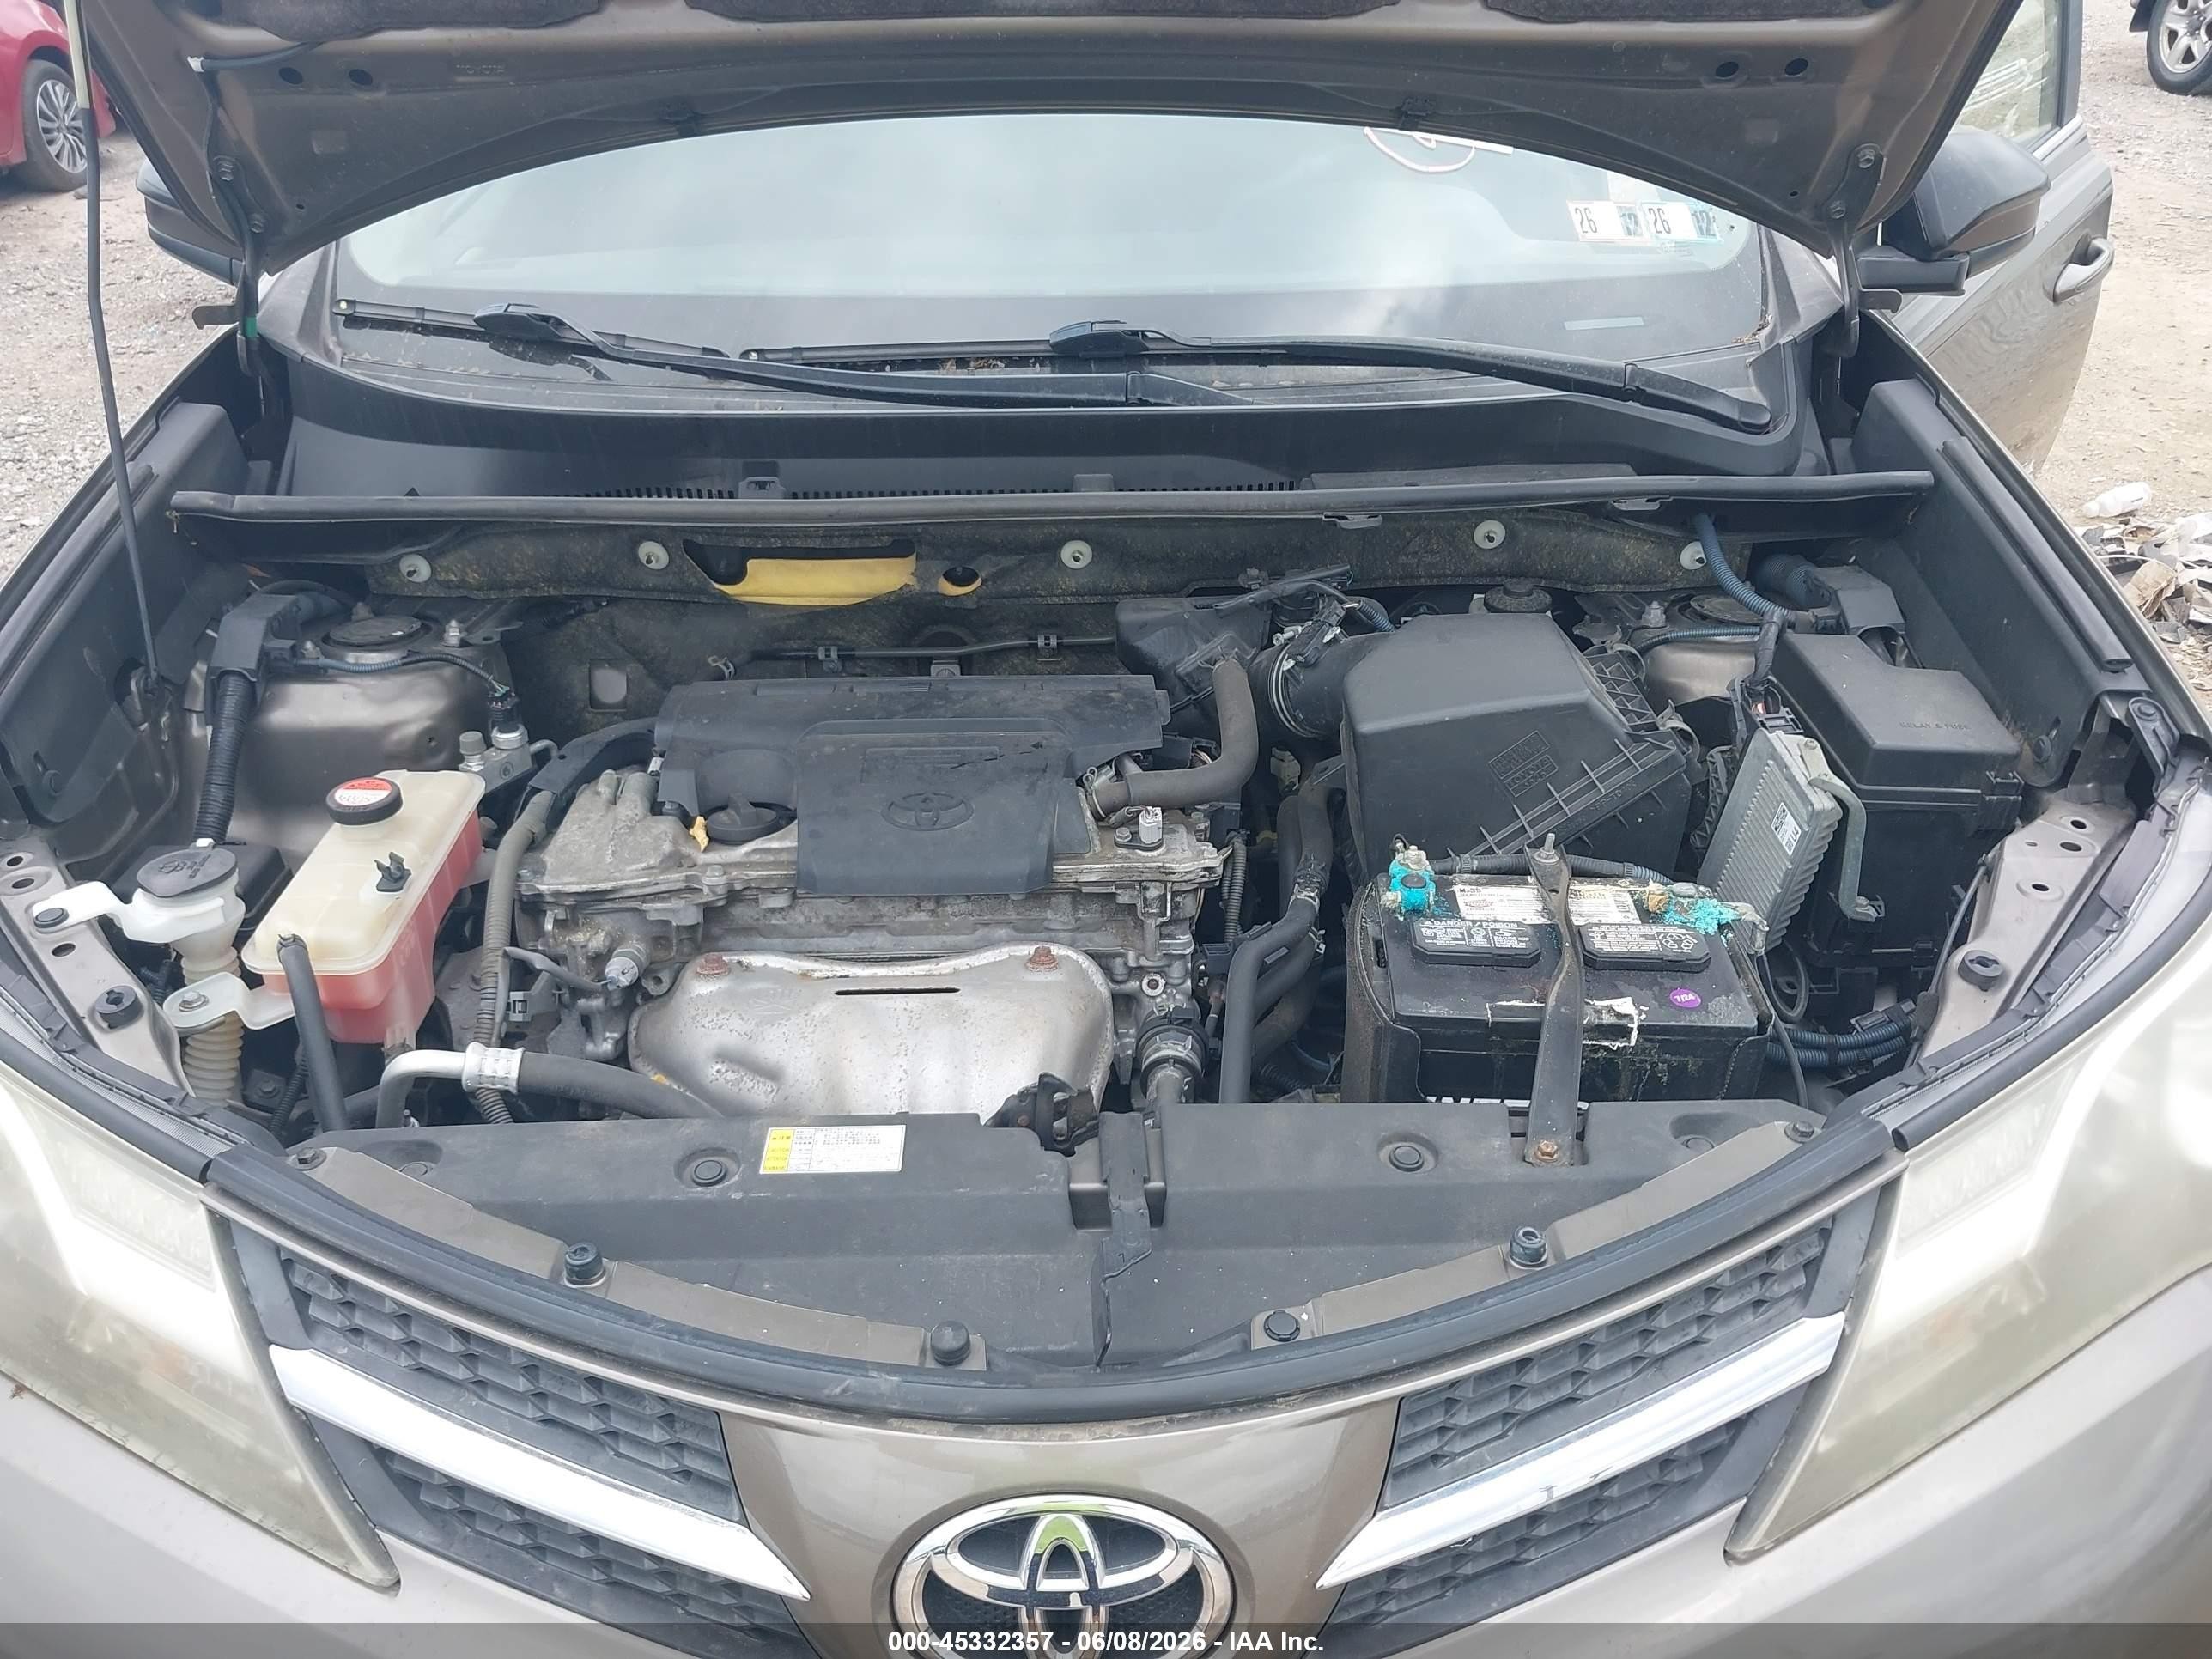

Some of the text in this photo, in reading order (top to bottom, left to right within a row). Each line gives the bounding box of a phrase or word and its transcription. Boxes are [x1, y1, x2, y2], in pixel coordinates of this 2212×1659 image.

[1574, 207, 1598, 234] 26
[1648, 208, 1717, 237] 26 12
[1434, 919, 1473, 927] DANGER
